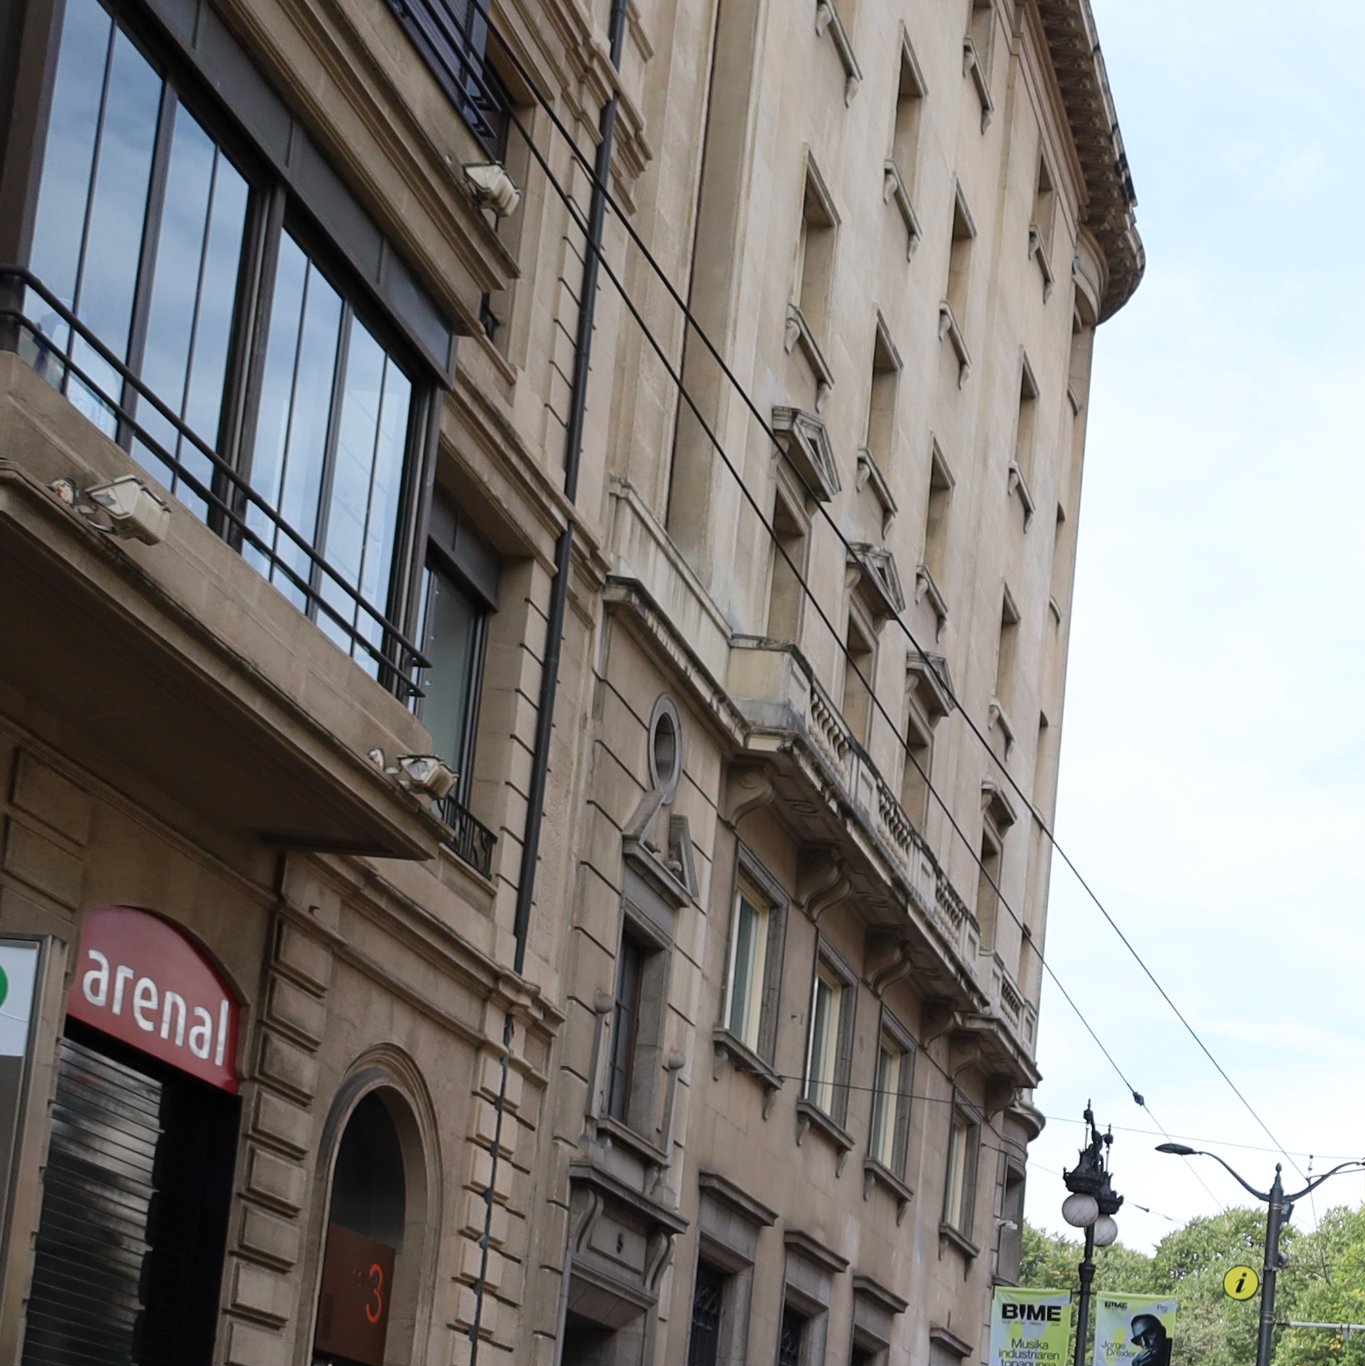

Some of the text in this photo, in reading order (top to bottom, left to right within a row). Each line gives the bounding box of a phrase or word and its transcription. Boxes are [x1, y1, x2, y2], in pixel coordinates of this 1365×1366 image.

[82, 950, 229, 1066] arenal
[365, 1263, 383, 1324] 3
[1002, 1303, 1062, 1321] BIME
[1011, 1338, 1048, 1349] Musika
[999, 1349, 1060, 1359] industriaren
